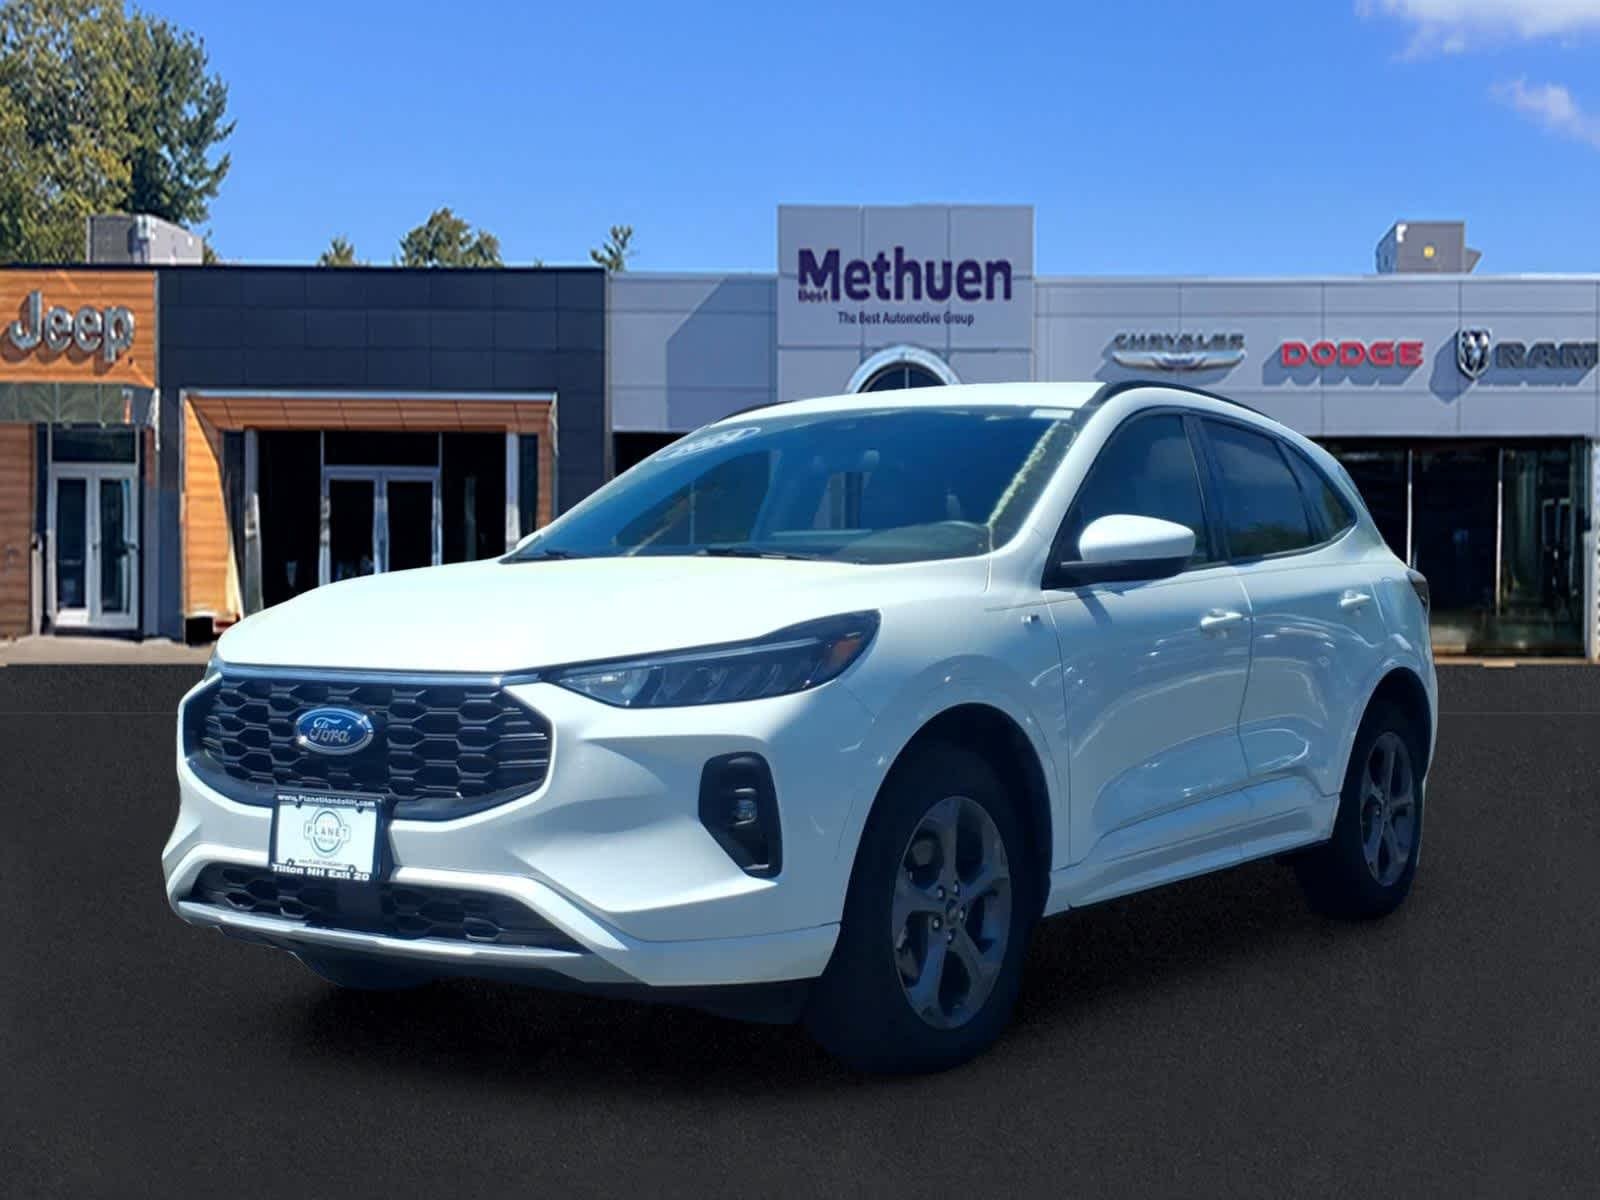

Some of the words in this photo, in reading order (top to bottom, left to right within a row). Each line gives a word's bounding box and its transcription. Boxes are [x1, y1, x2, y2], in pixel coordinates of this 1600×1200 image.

[798, 247, 1012, 300] Methuen
[9, 290, 135, 363] Jeep
[838, 311, 856, 324] The
[859, 311, 880, 324] Best
[883, 311, 941, 324] Automotive
[943, 311, 974, 326] Group
[1114, 333, 1245, 349] CHRYSLER
[1281, 341, 1424, 367] DODGE
[1495, 341, 1598, 369] RAM
[309, 717, 352, 743] Ford
[307, 824, 347, 838] PLANET
[272, 864, 304, 875] Tilton
[307, 867, 325, 877] NH
[328, 868, 351, 879] Exit
[353, 872, 370, 881] 20
